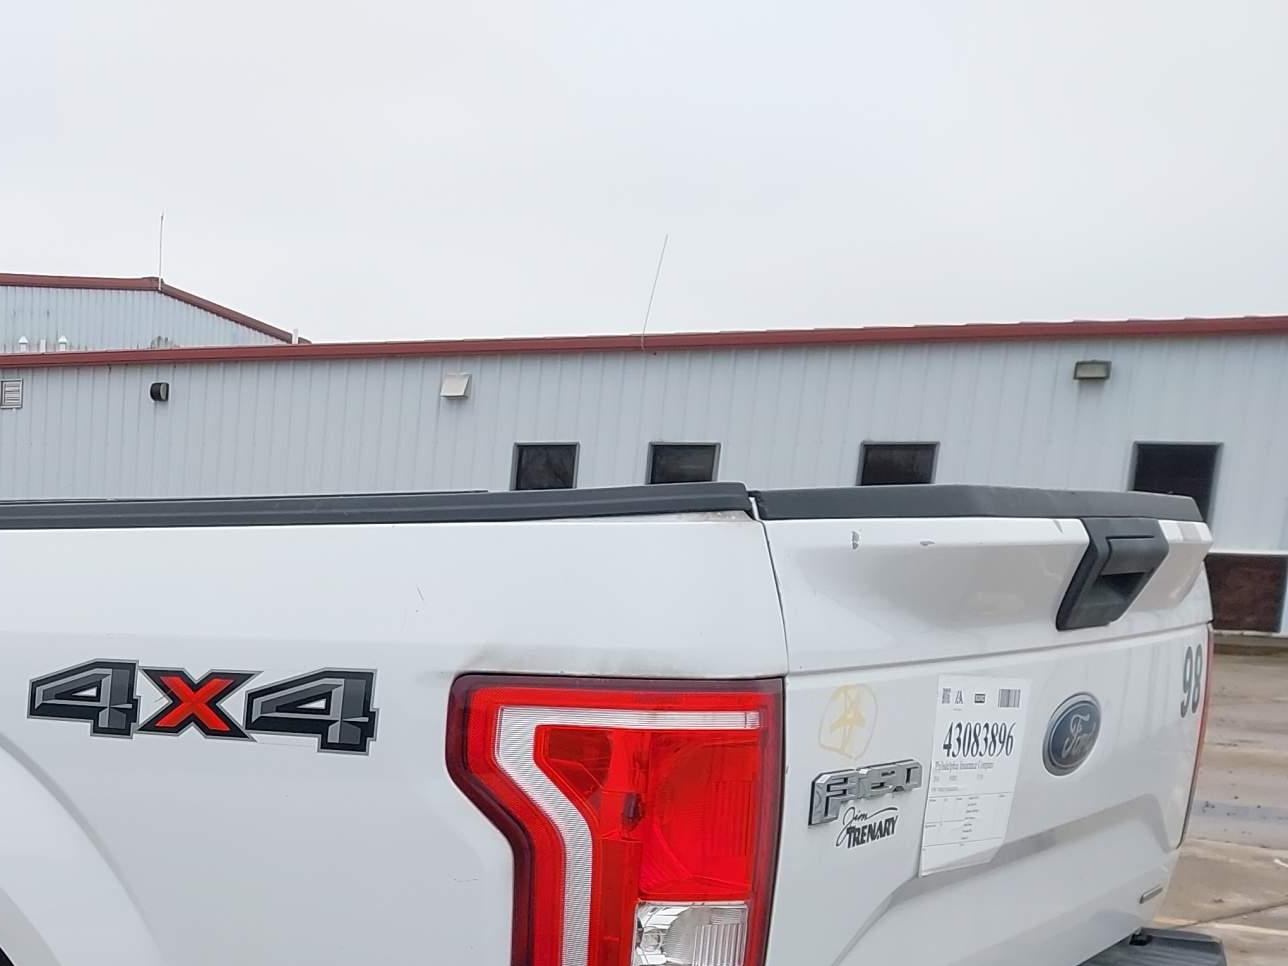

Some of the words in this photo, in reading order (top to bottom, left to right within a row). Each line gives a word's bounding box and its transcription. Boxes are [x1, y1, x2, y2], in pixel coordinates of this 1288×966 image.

[1180, 643, 1203, 719] 98
[941, 721, 1017, 758] 43083896
[845, 815, 899, 849] TRENARY
